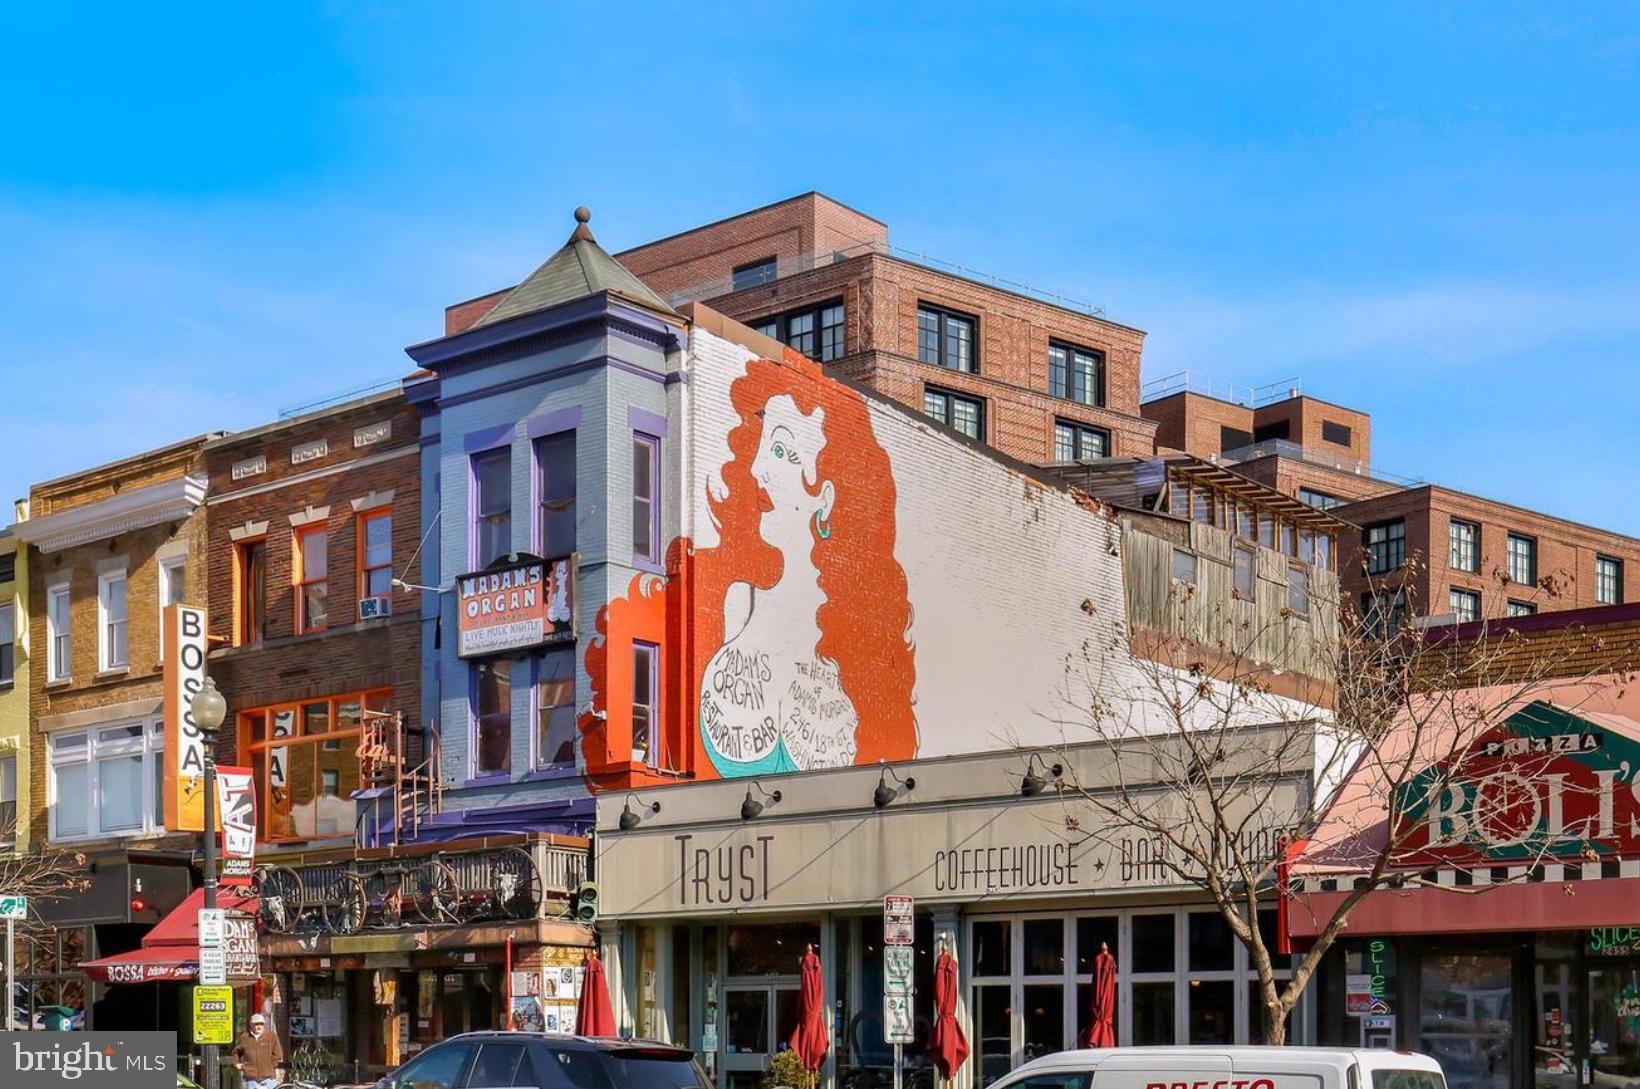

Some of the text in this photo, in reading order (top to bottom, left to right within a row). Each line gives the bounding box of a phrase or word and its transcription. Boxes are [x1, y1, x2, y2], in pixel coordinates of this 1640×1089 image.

[467, 589, 536, 618] ORGAN
[465, 631, 485, 642] LIVE
[181, 611, 202, 773] BOSSA
[713, 670, 765, 710] ORGAN
[752, 716, 777, 753] BAR
[790, 707, 815, 744] 2461
[1486, 734, 1597, 757] PIZZA
[221, 775, 254, 854] EAT
[222, 867, 252, 876] MORGAN
[226, 859, 251, 867] ADAMS
[674, 834, 774, 905] TRYST
[935, 843, 1079, 892] COFFEEHOUSE
[1120, 837, 1167, 881] BAR
[107, 965, 144, 982] BOSSA
[1370, 941, 1385, 998] SLICE
